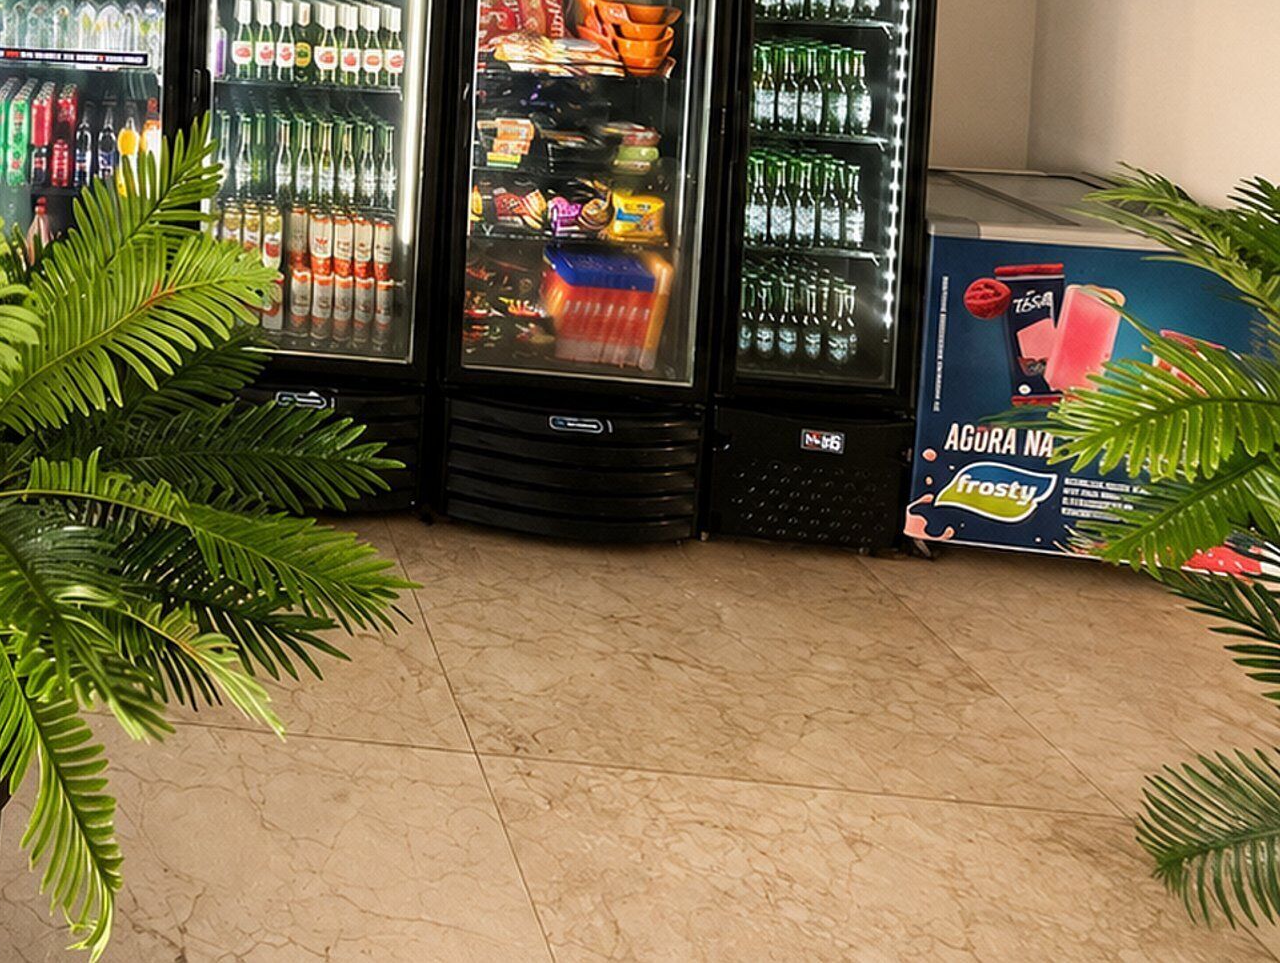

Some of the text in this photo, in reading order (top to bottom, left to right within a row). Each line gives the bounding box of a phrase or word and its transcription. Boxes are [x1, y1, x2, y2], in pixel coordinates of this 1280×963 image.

[944, 422, 1054, 458] AGORA NA
[956, 474, 1038, 505] frosty
